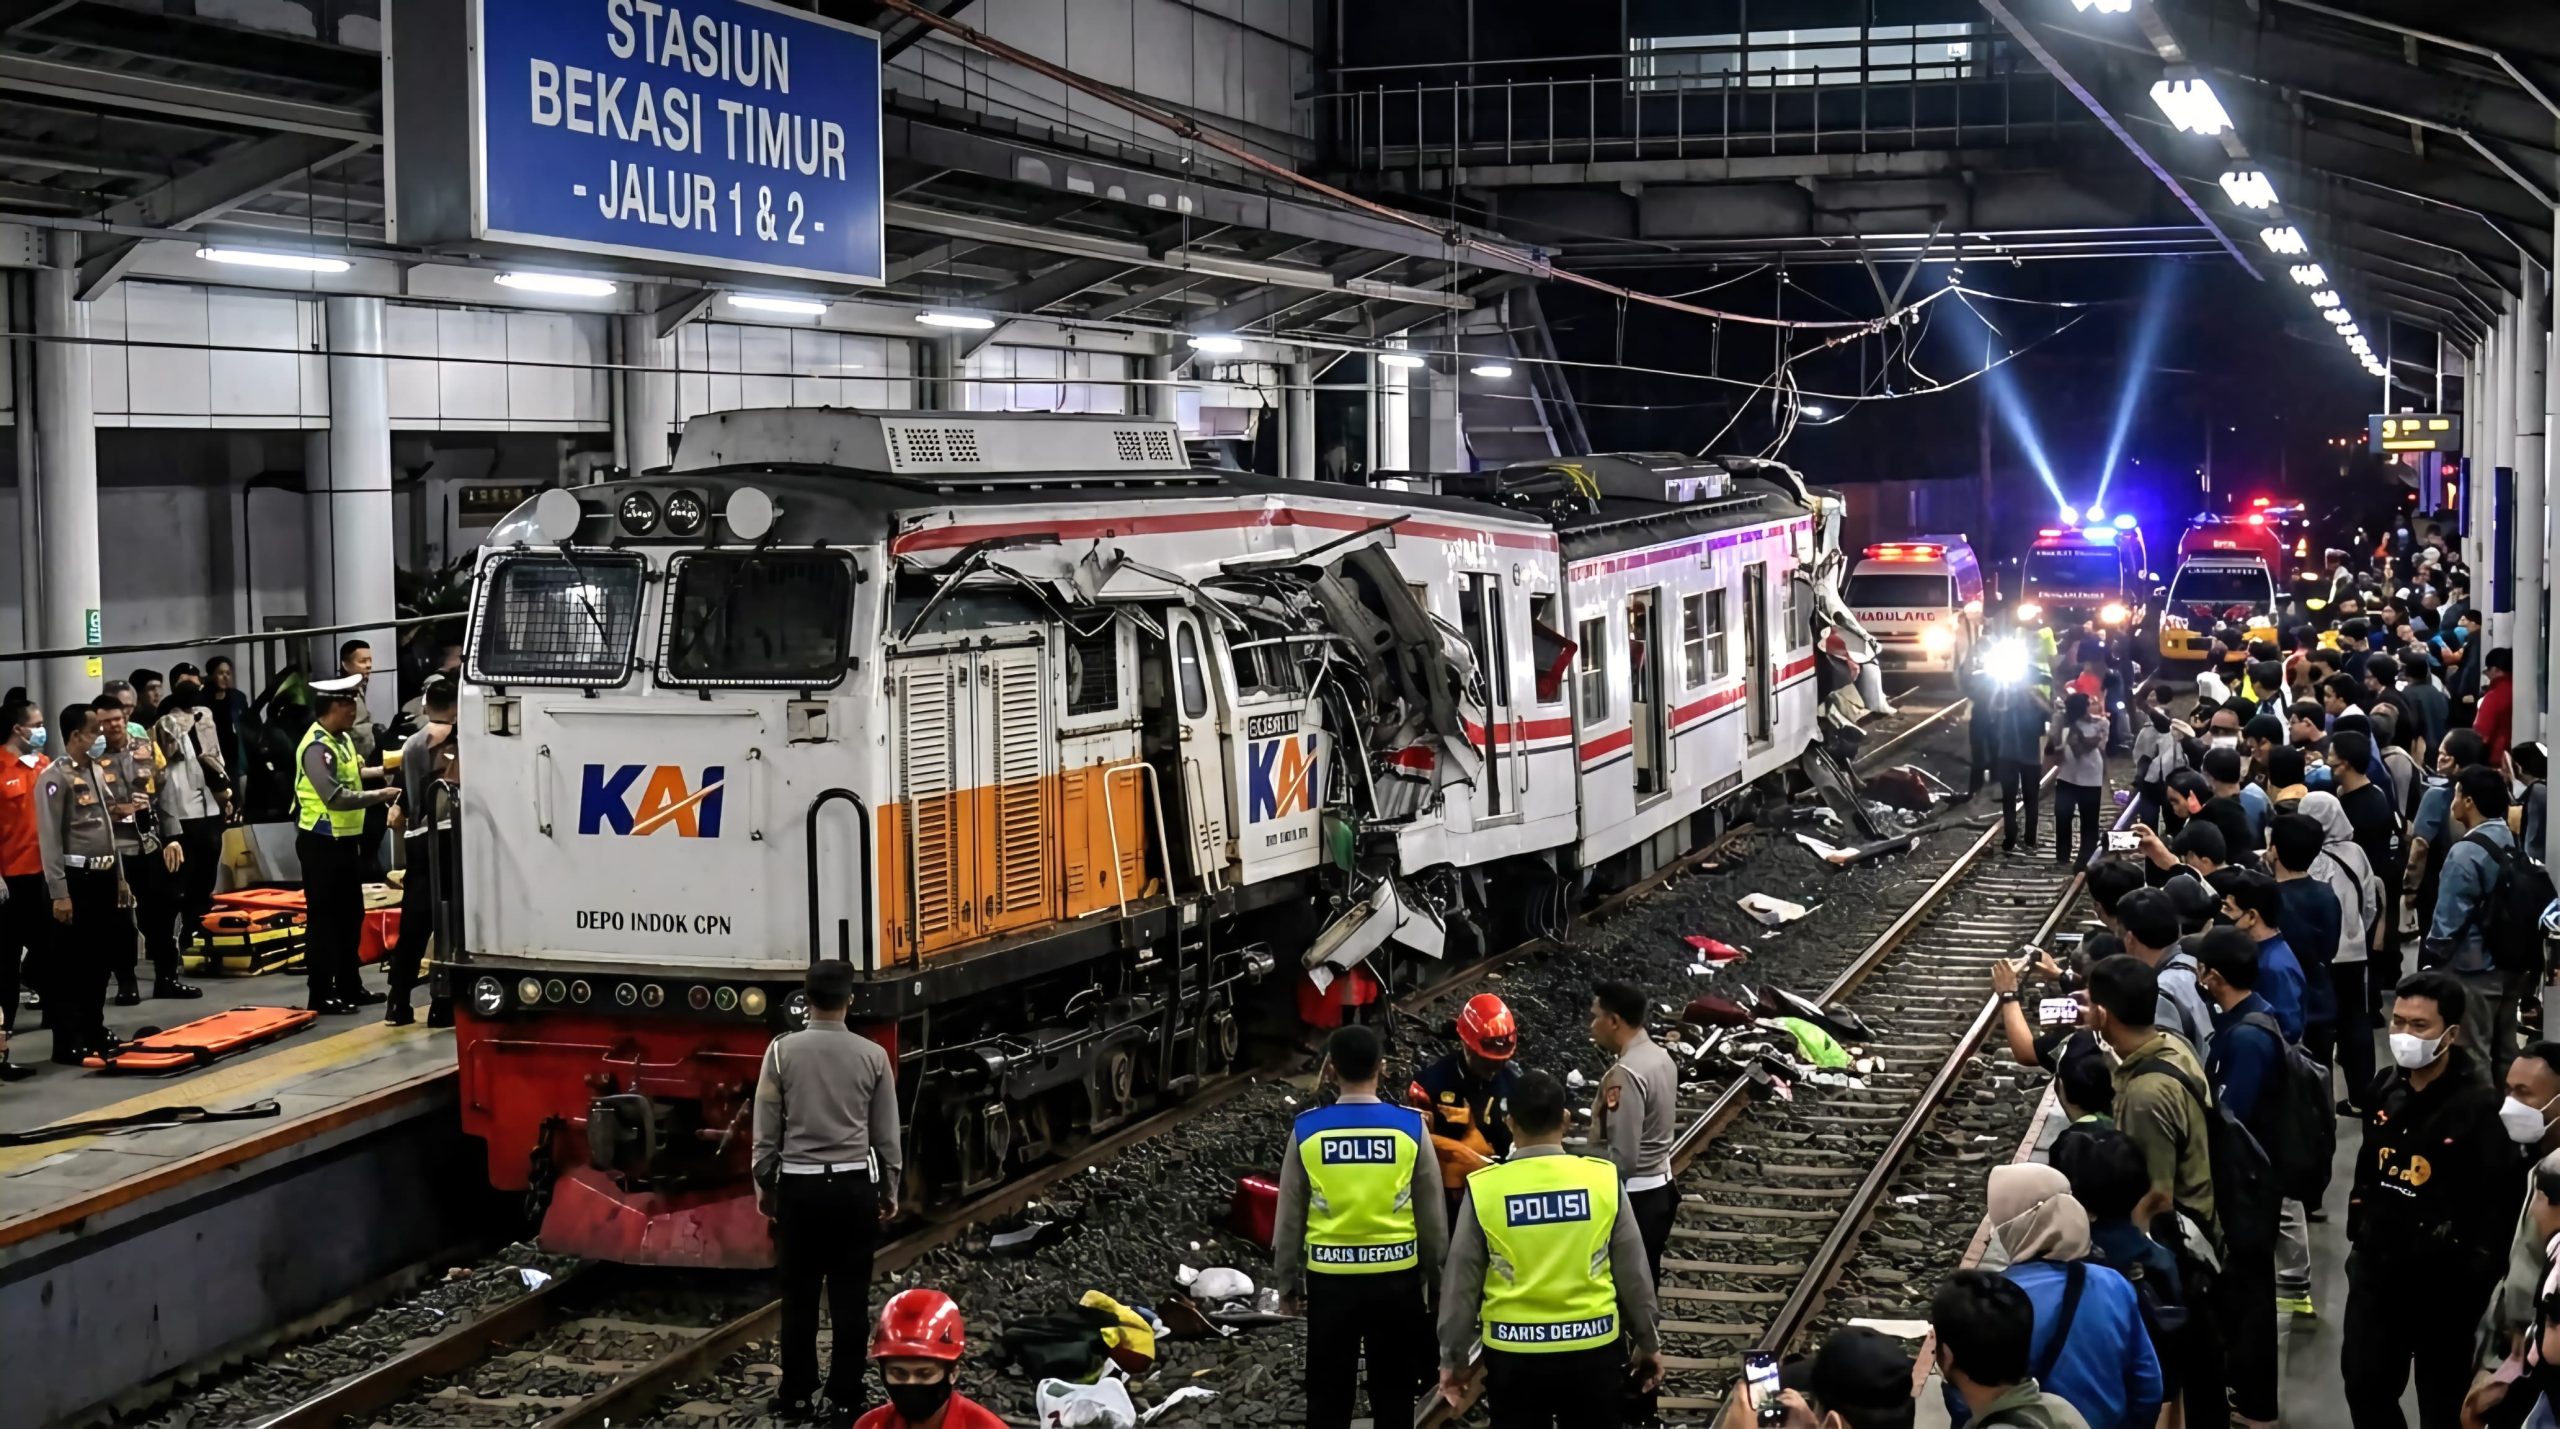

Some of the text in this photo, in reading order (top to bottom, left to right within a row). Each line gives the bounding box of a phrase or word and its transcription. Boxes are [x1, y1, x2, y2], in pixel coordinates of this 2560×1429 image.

[607, 0, 789, 94] STASIUN
[530, 58, 846, 181] BEKASI TIMUR
[599, 159, 717, 232] JALUR
[728, 182, 742, 236] 1
[756, 185, 778, 242] &
[787, 191, 805, 245] 2
[578, 764, 725, 838] KAI
[1248, 734, 1318, 824] KAI
[576, 911, 731, 935] DEPO INDOK CPN
[1324, 1138, 1393, 1161] POLISI
[1509, 1193, 1588, 1222] POLISI
